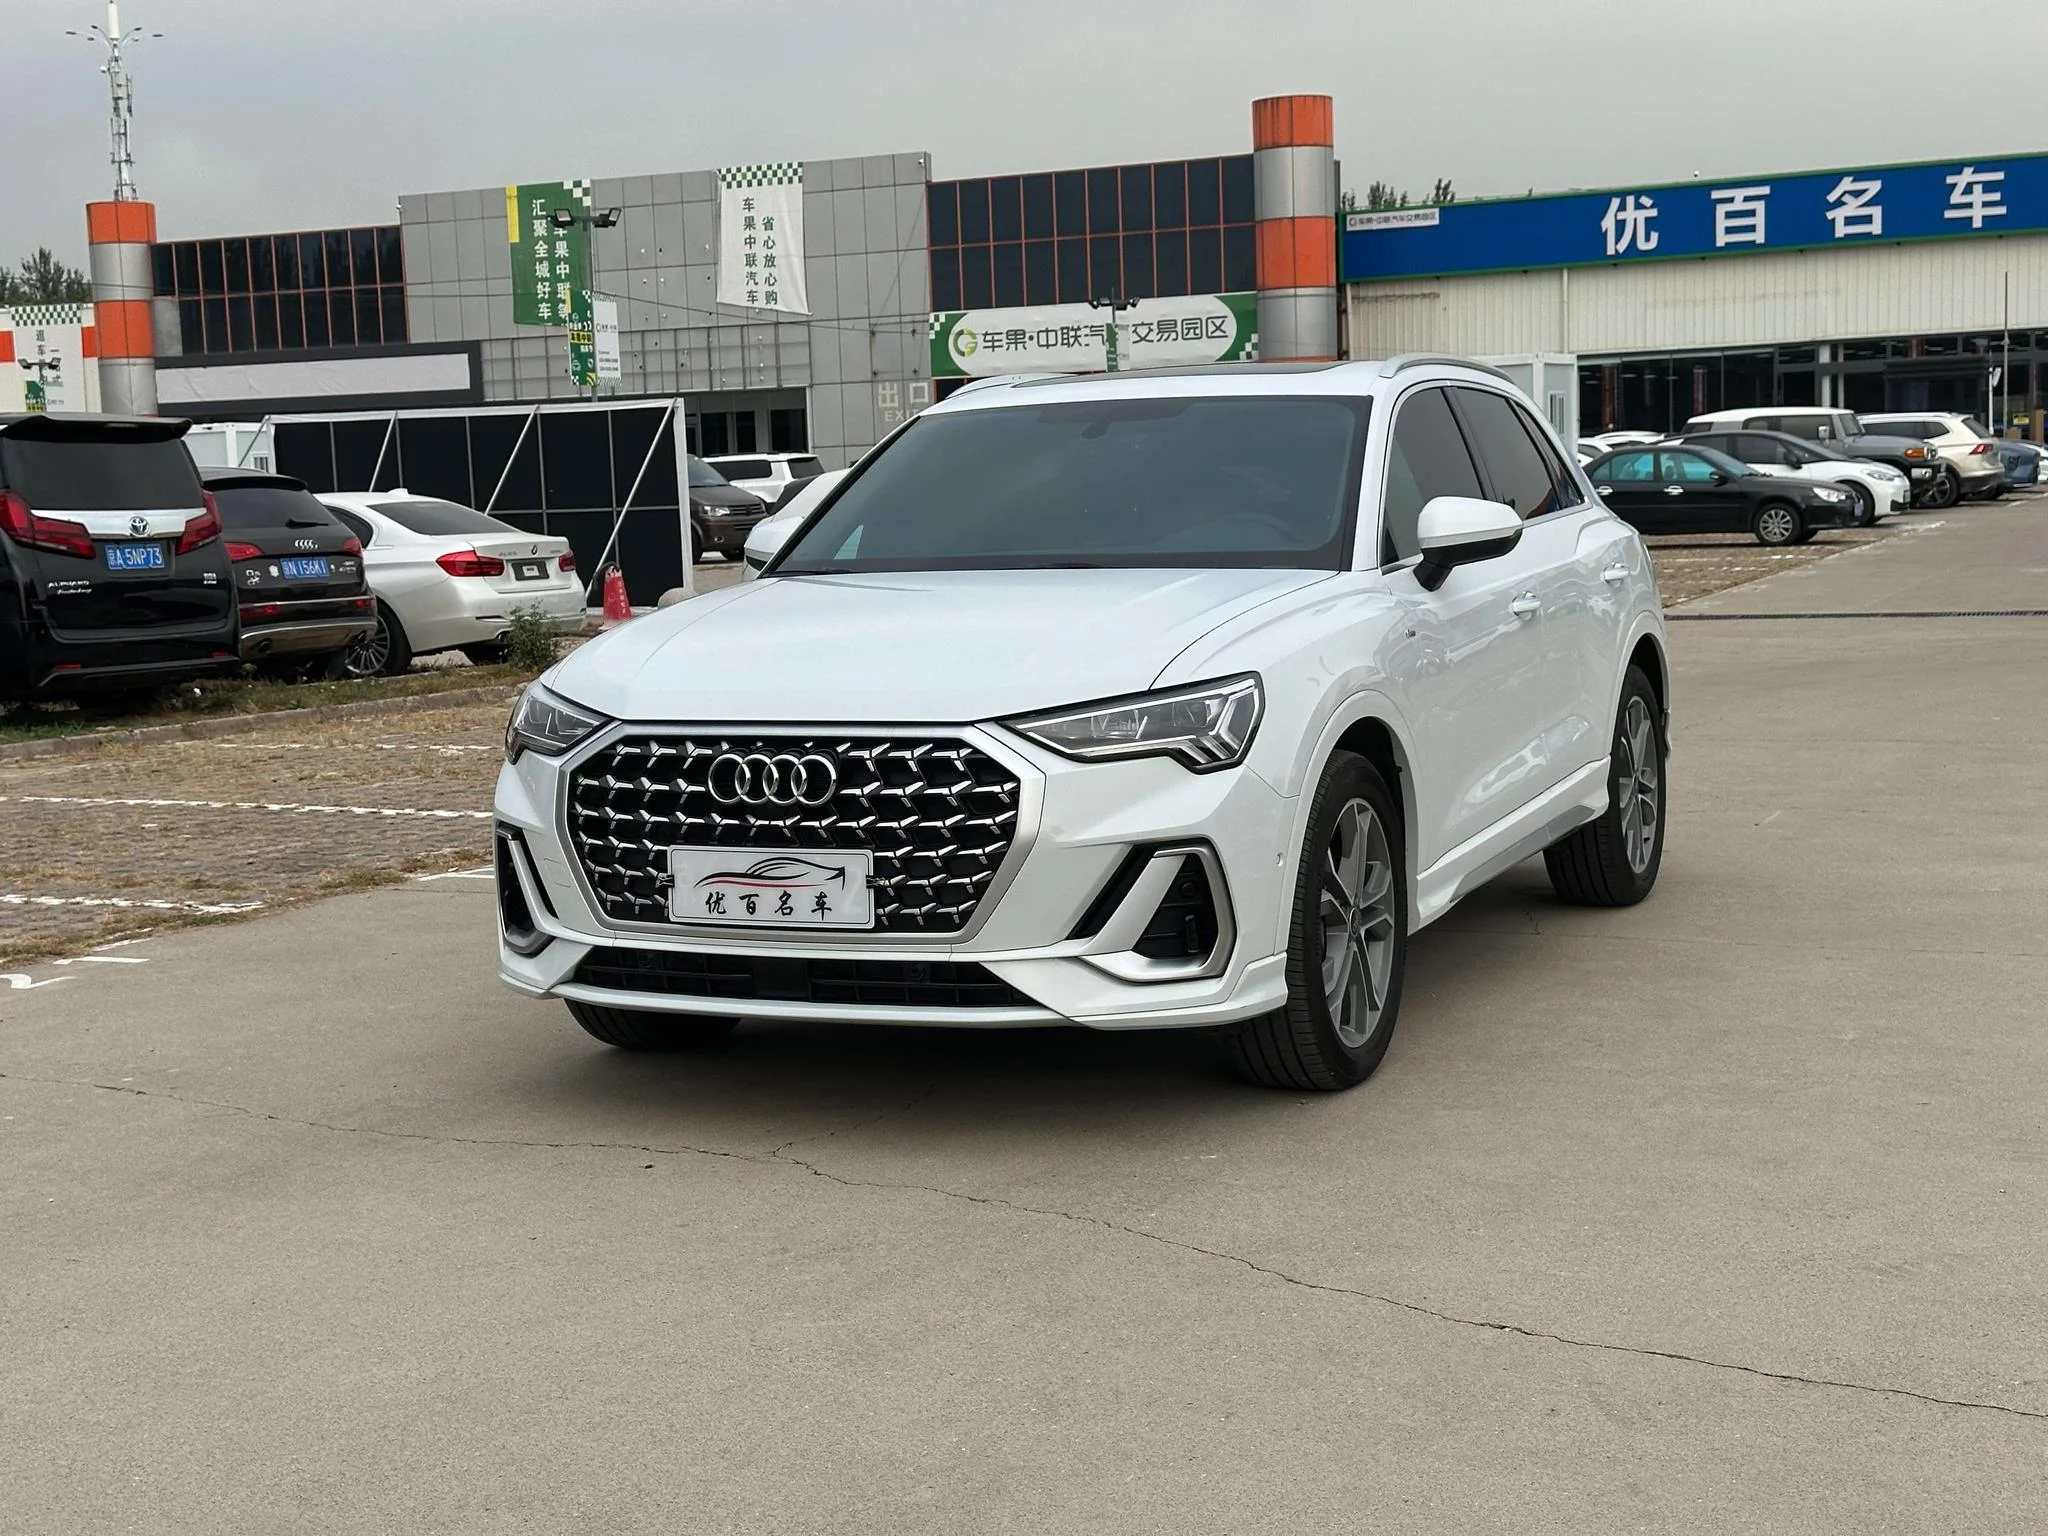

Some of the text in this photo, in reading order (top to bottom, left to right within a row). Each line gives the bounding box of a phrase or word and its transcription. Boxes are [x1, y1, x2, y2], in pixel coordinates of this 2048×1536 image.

[742, 196, 759, 305] 车果中联汽车
[1600, 166, 2008, 256] 优百名车
[532, 198, 552, 320] 汇聚全城好车
[762, 215, 778, 306] 省心放心购
[982, 315, 1229, 353] 车果·中联汽交易园区
[878, 382, 929, 409] 出口
[705, 890, 833, 922] 优百名车
